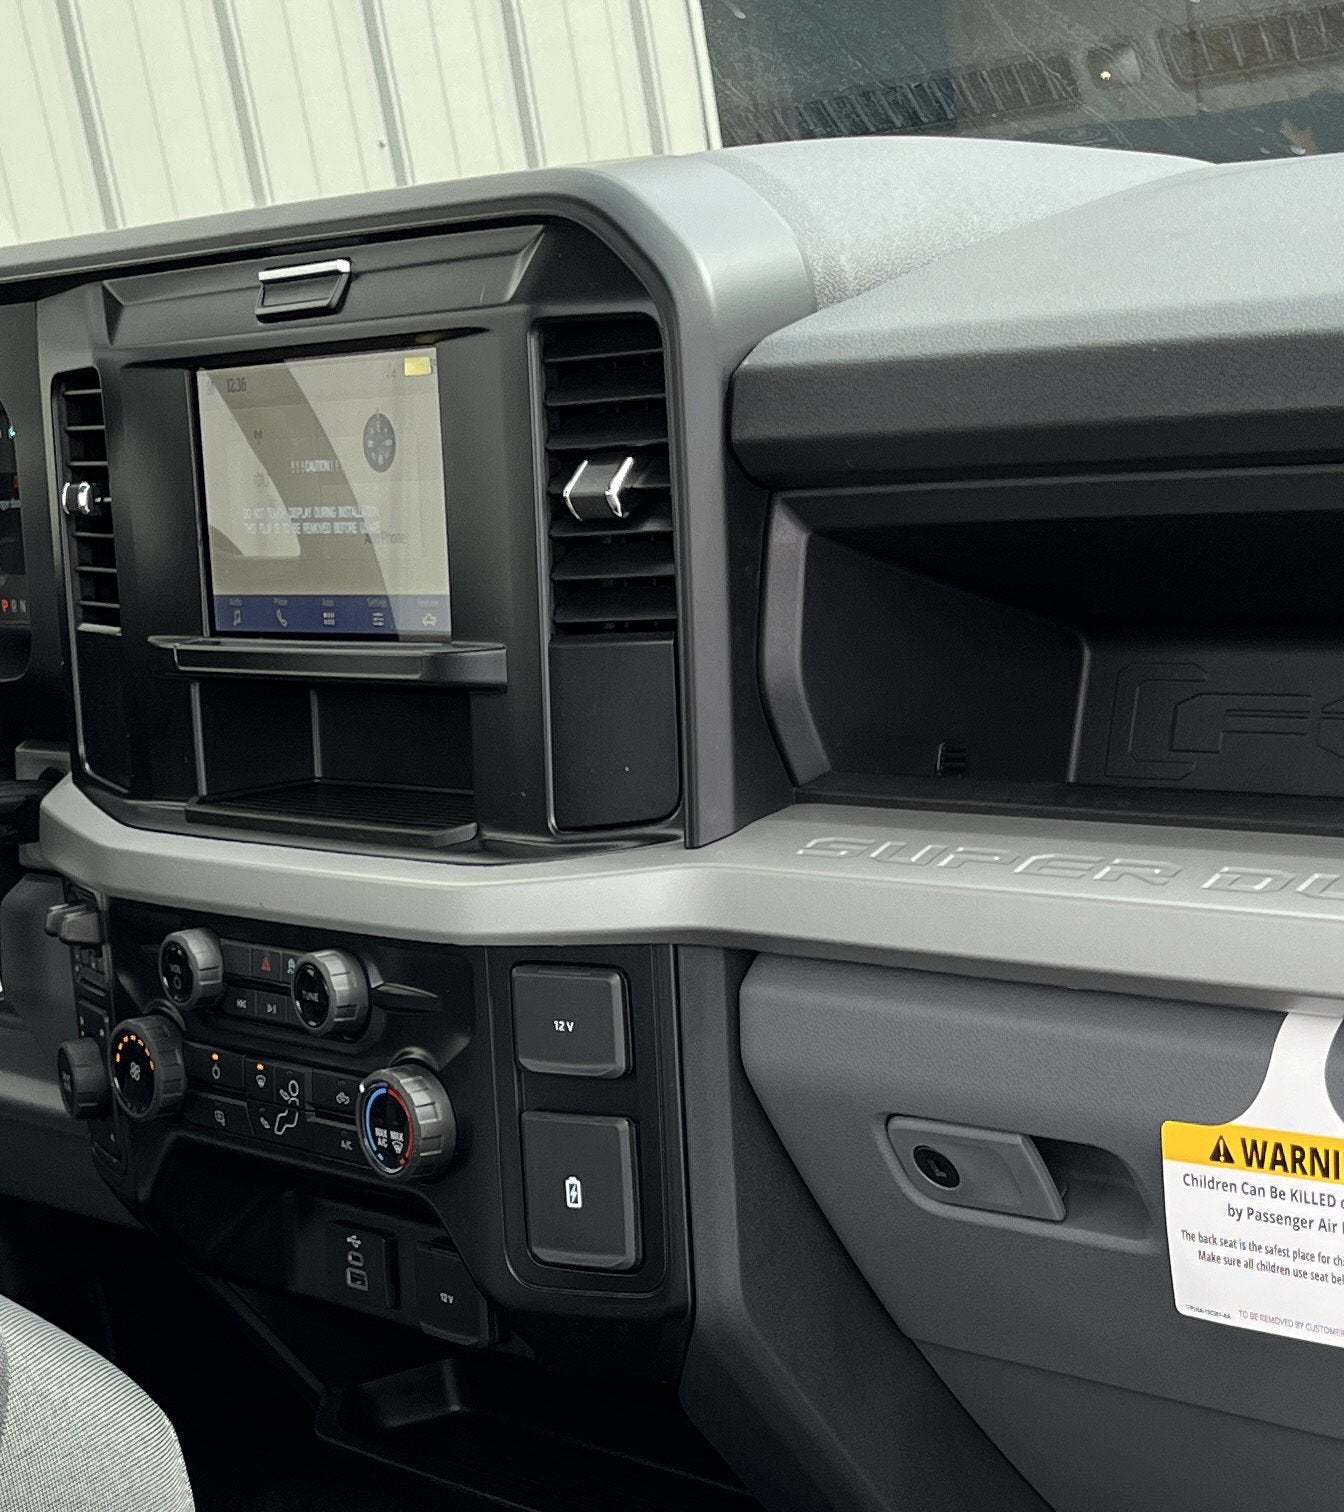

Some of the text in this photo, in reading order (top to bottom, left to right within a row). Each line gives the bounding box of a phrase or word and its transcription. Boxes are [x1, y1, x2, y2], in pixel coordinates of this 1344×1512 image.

[796, 836, 1184, 886] SUPER
[1183, 1173, 1237, 1194] Children
[1241, 1182, 1266, 1200] Can
[1270, 1186, 1286, 1201] Be
[1290, 1188, 1337, 1208] KILLED
[1227, 1203, 1243, 1222] by
[1247, 1207, 1315, 1231] Passenger
[1318, 1217, 1338, 1234] Air
[1181, 1229, 1196, 1242] The
[1198, 1231, 1217, 1246] back
[1219, 1237, 1237, 1250] seat
[1239, 1239, 1247, 1251] is
[1249, 1241, 1263, 1254] the
[1265, 1244, 1291, 1259] safest
[1292, 1247, 1316, 1263] place
[1317, 1251, 1331, 1265] for
[1198, 1249, 1222, 1265] Make
[1223, 1255, 1242, 1268] sure
[1243, 1258, 1254, 1270] all
[1256, 1260, 1291, 1277] children
[1293, 1267, 1308, 1281] use
[1310, 1270, 1329, 1284] seat
[1238, 1309, 1249, 1319] TO
[1250, 1312, 1259, 1321] BE
[1259, 1313, 1294, 1328] REMOVED
[1295, 1320, 1304, 1330] BY
